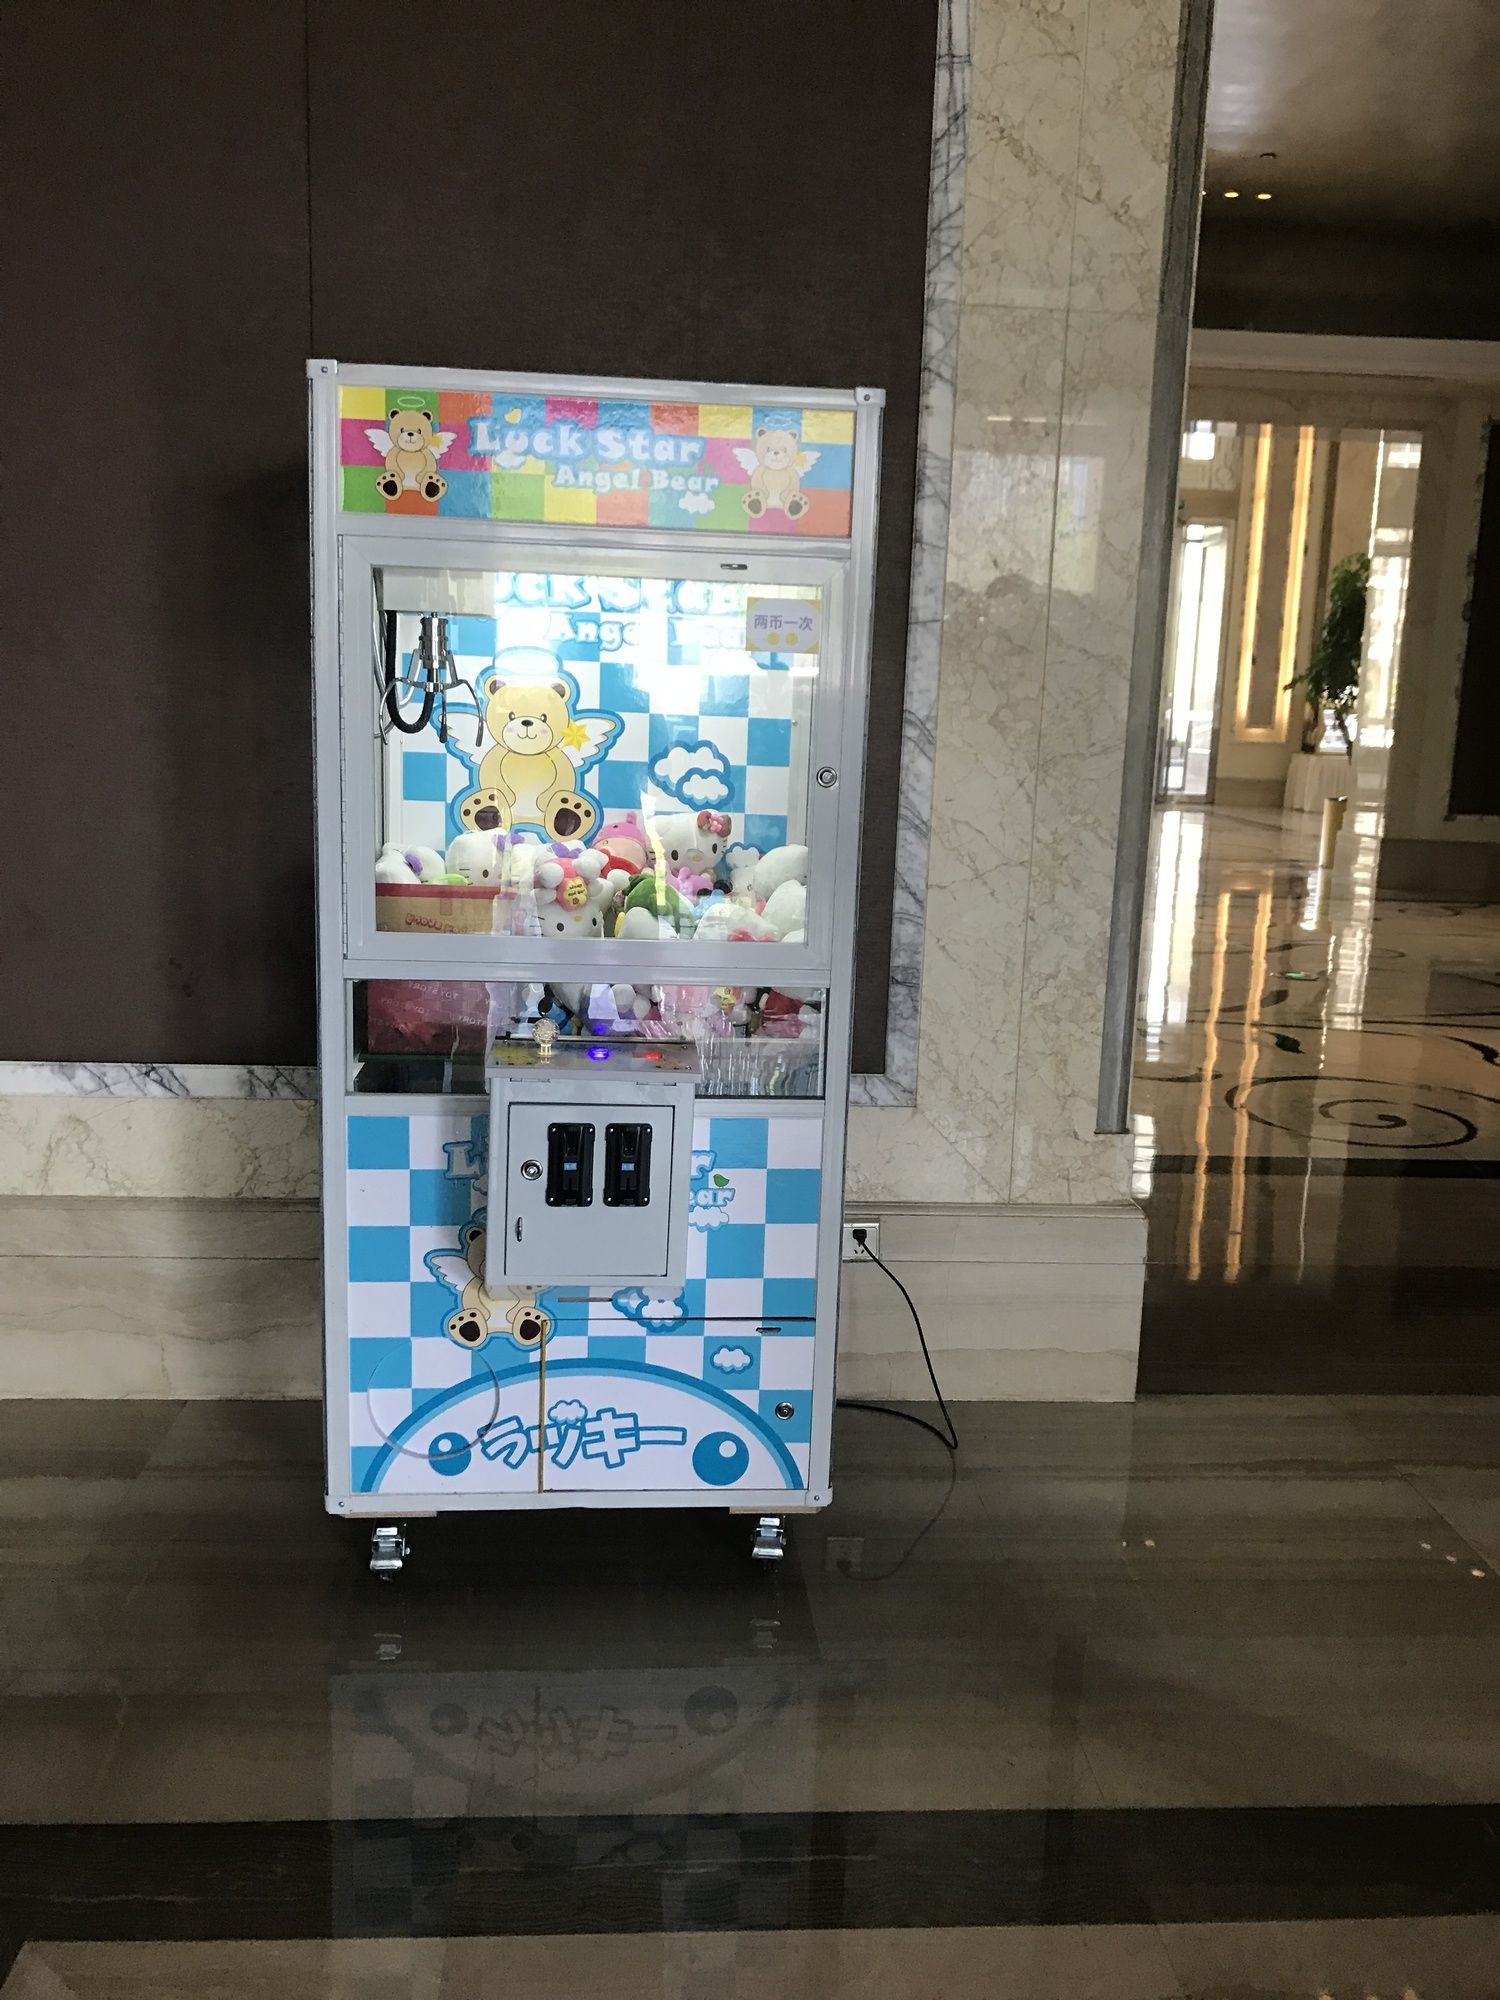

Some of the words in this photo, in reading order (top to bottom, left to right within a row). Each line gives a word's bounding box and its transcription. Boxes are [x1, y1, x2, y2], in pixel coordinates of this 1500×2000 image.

[472, 419, 586, 458] Luck
[596, 425, 702, 464] Star
[554, 463, 643, 494] Angel
[650, 468, 721, 494] Bear
[753, 614, 814, 632] 两币一次
